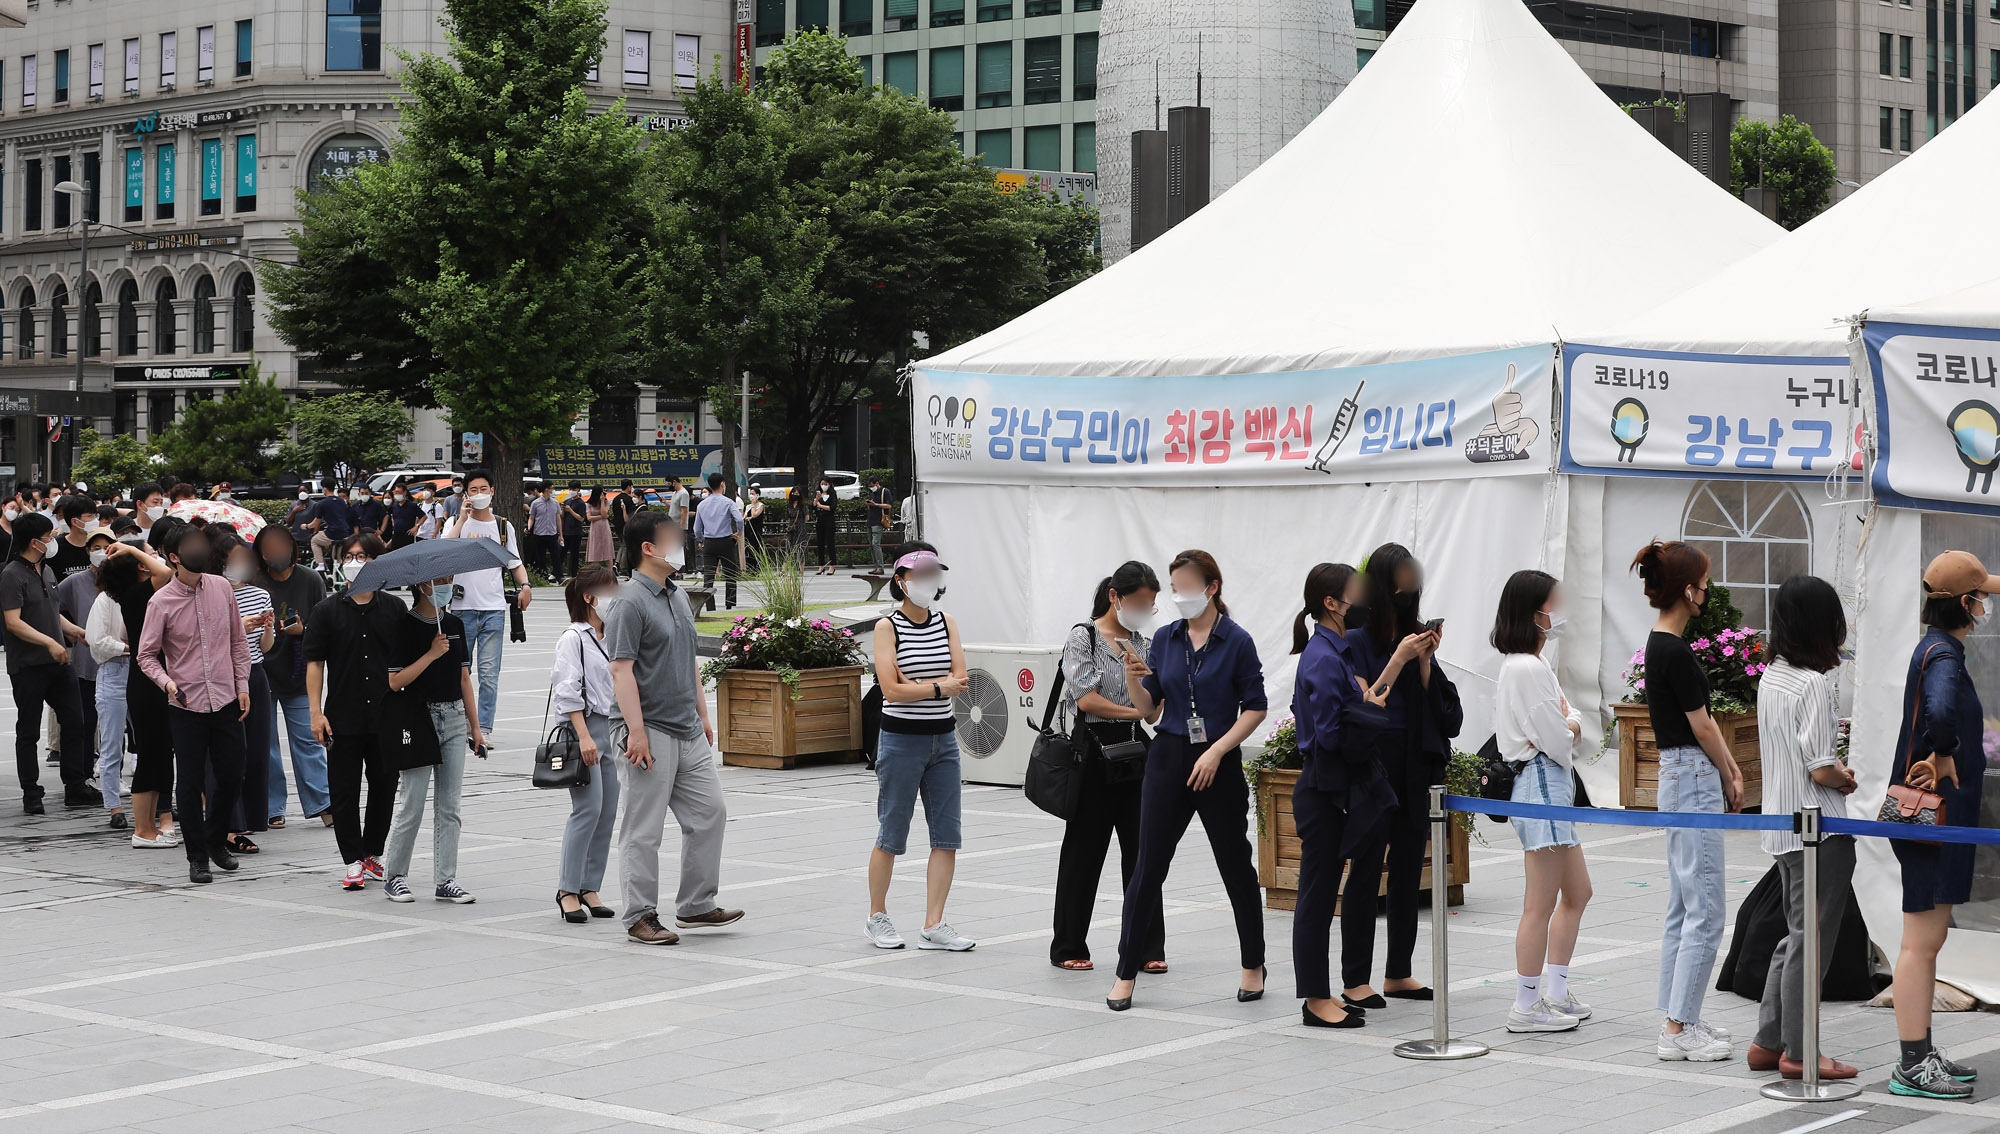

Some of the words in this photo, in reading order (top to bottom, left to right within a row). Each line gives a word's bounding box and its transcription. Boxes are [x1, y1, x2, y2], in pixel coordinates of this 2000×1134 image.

[164, 48, 176, 60] 안과
[627, 46, 644, 58] 안과
[677, 50, 694, 62] 의원
[245, 144, 253, 187] 치매
[1058, 177, 1094, 198] 스킨케어
[155, 235, 176, 249] JUNO
[178, 233, 199, 248] HAIR
[152, 368, 172, 379] PARIS
[172, 367, 210, 378] CROISSANT
[1594, 365, 1670, 391] 코로나19
[1916, 352, 1999, 388] 코로나
[1786, 377, 1862, 408] 누구나
[988, 406, 1149, 465] 강남구민이
[1164, 408, 1234, 465] 최강
[1244, 404, 1313, 462] 백신
[1359, 399, 1457, 455] 입니다
[1465, 434, 1518, 455] #덕분에
[1685, 414, 1833, 471] 강남구
[545, 448, 565, 461] 전동
[567, 449, 595, 461] 킥보드
[598, 448, 616, 461] 이용
[620, 449, 629, 461] 시
[631, 448, 668, 461] 교통법규
[669, 448, 688, 461] 준수
[689, 448, 699, 461] 및
[930, 445, 972, 461] GANGNAM
[1489, 453, 1515, 461] COVID-19
[547, 463, 595, 476] 안전운전을
[1019, 696, 1034, 708] LG
